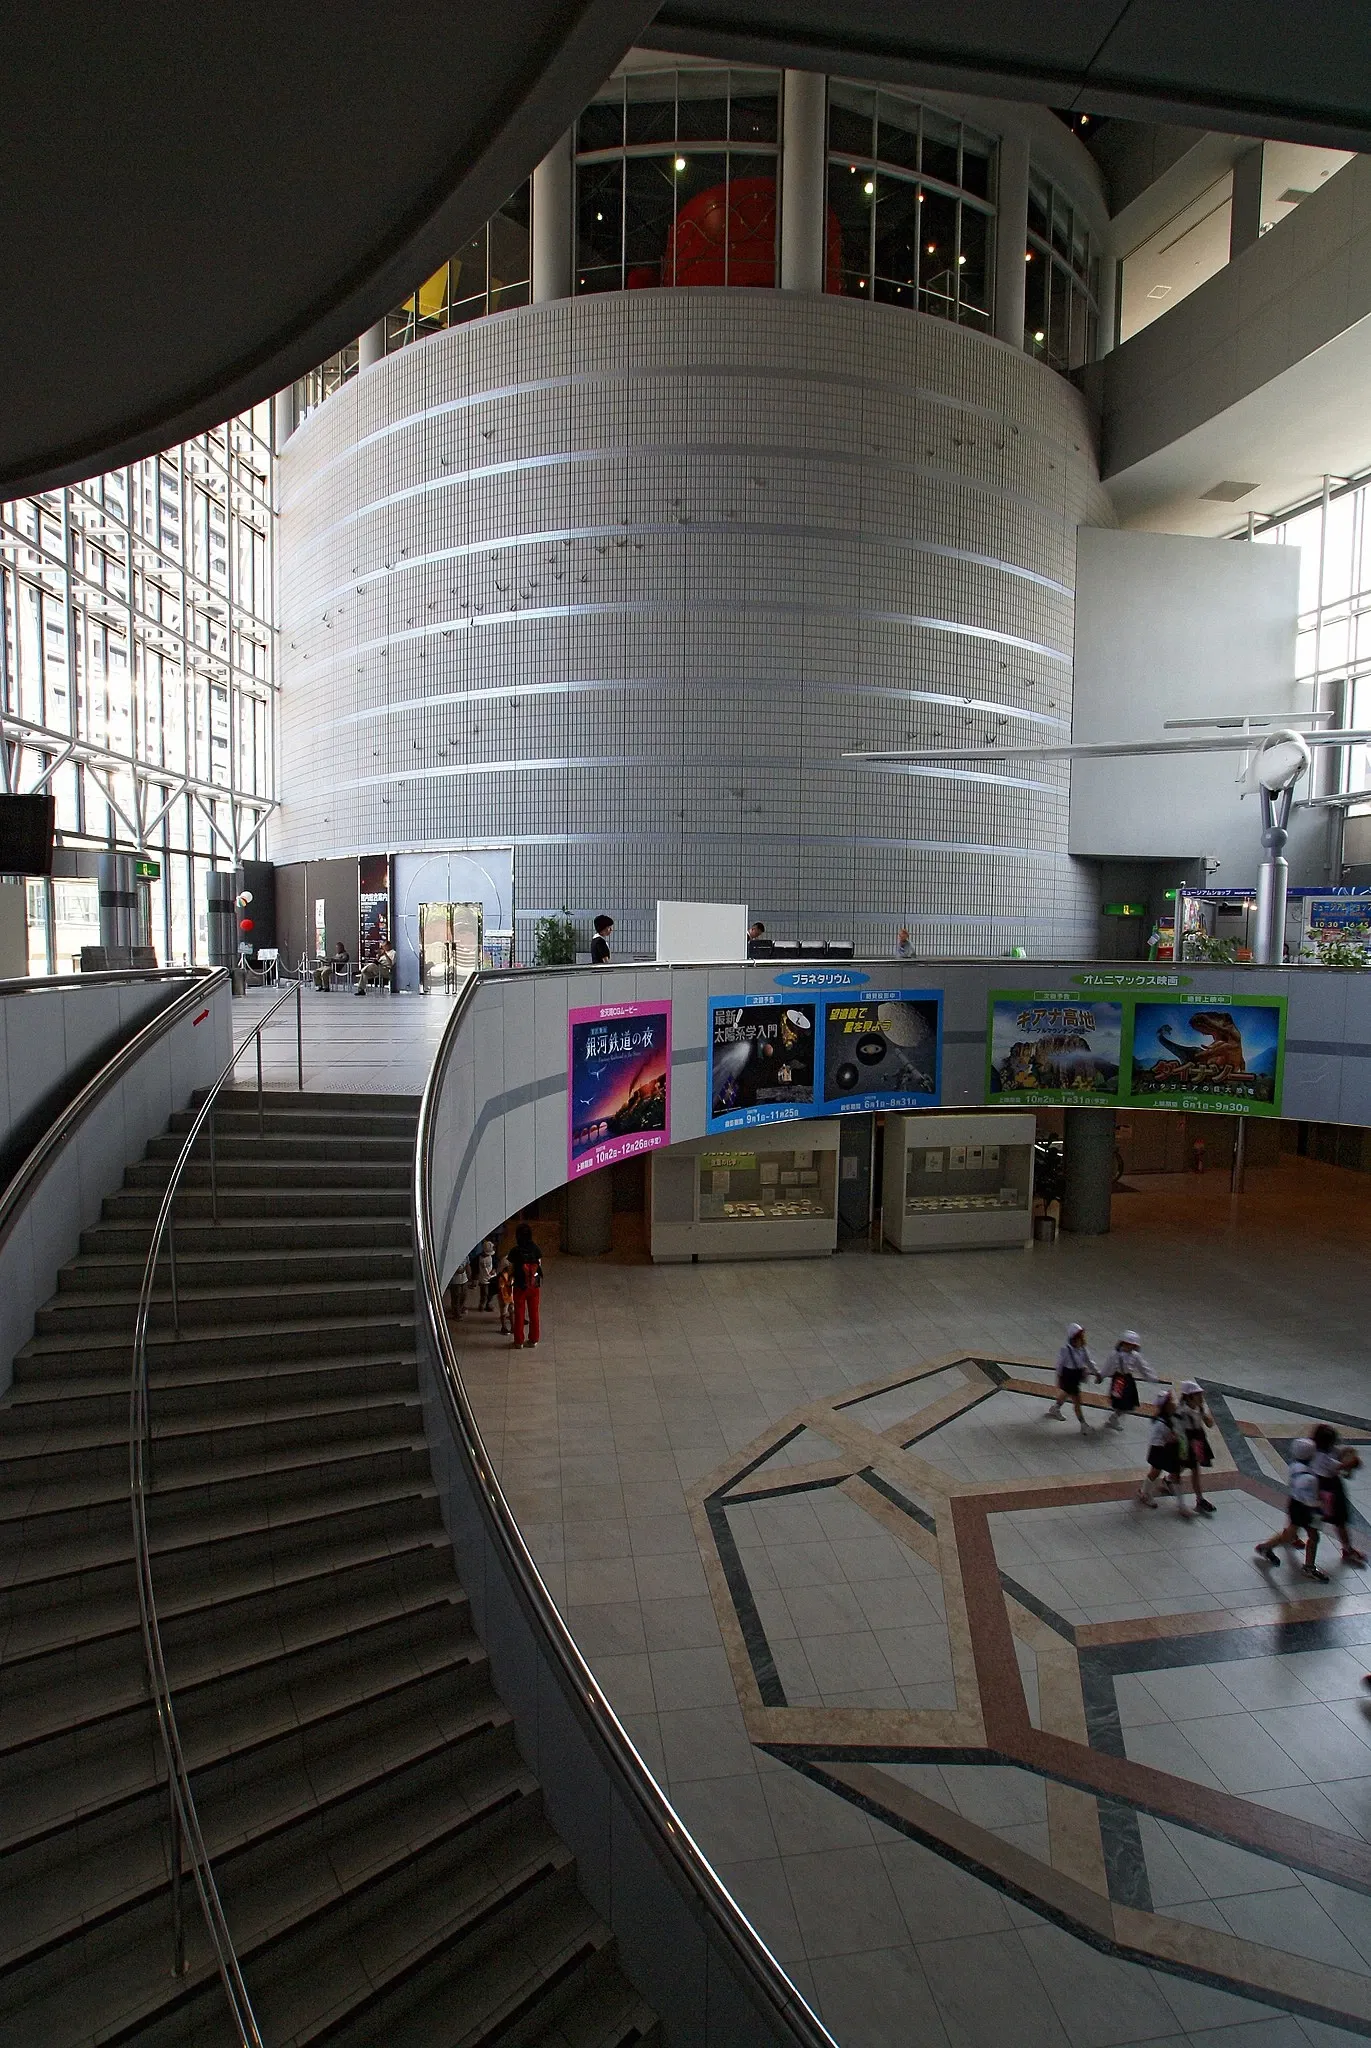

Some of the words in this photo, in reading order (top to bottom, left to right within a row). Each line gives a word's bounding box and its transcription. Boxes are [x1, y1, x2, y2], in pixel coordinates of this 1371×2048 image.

[792, 974, 851, 985] プラネタリウム
[1084, 976, 1178, 986] オムニマックス映画
[714, 1008, 743, 1029] 最新!
[829, 1008, 868, 1020] 望遠鏡で
[714, 1024, 778, 1043] 太陽系学入門
[843, 1020, 892, 1033] 星を見よう
[586, 1026, 654, 1060] 銀河鉄道の夜
[1152, 1061, 1256, 1082] ダイナソー
